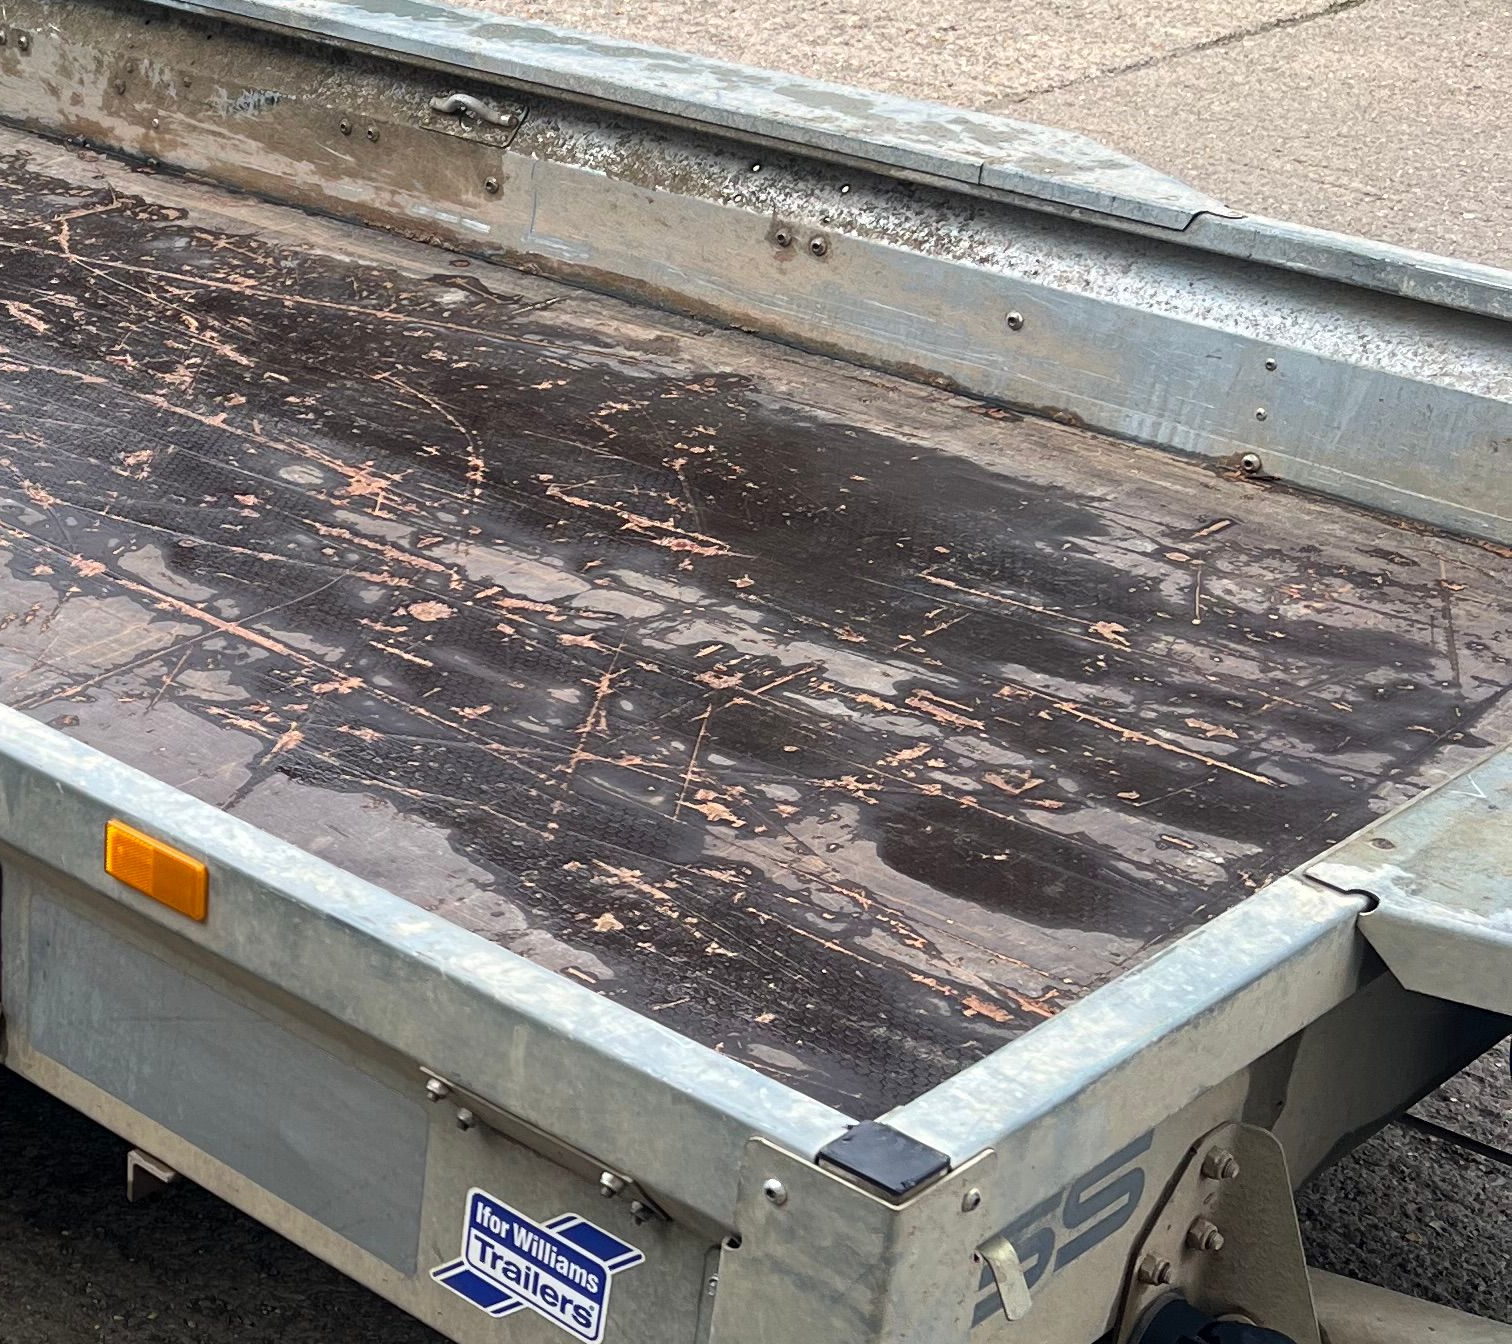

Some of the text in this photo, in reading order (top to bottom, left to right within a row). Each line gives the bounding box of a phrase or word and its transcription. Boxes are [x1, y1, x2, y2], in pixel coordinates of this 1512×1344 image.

[474, 1232, 593, 1329] Trailers
[475, 1201, 599, 1294] Ifor Williams
